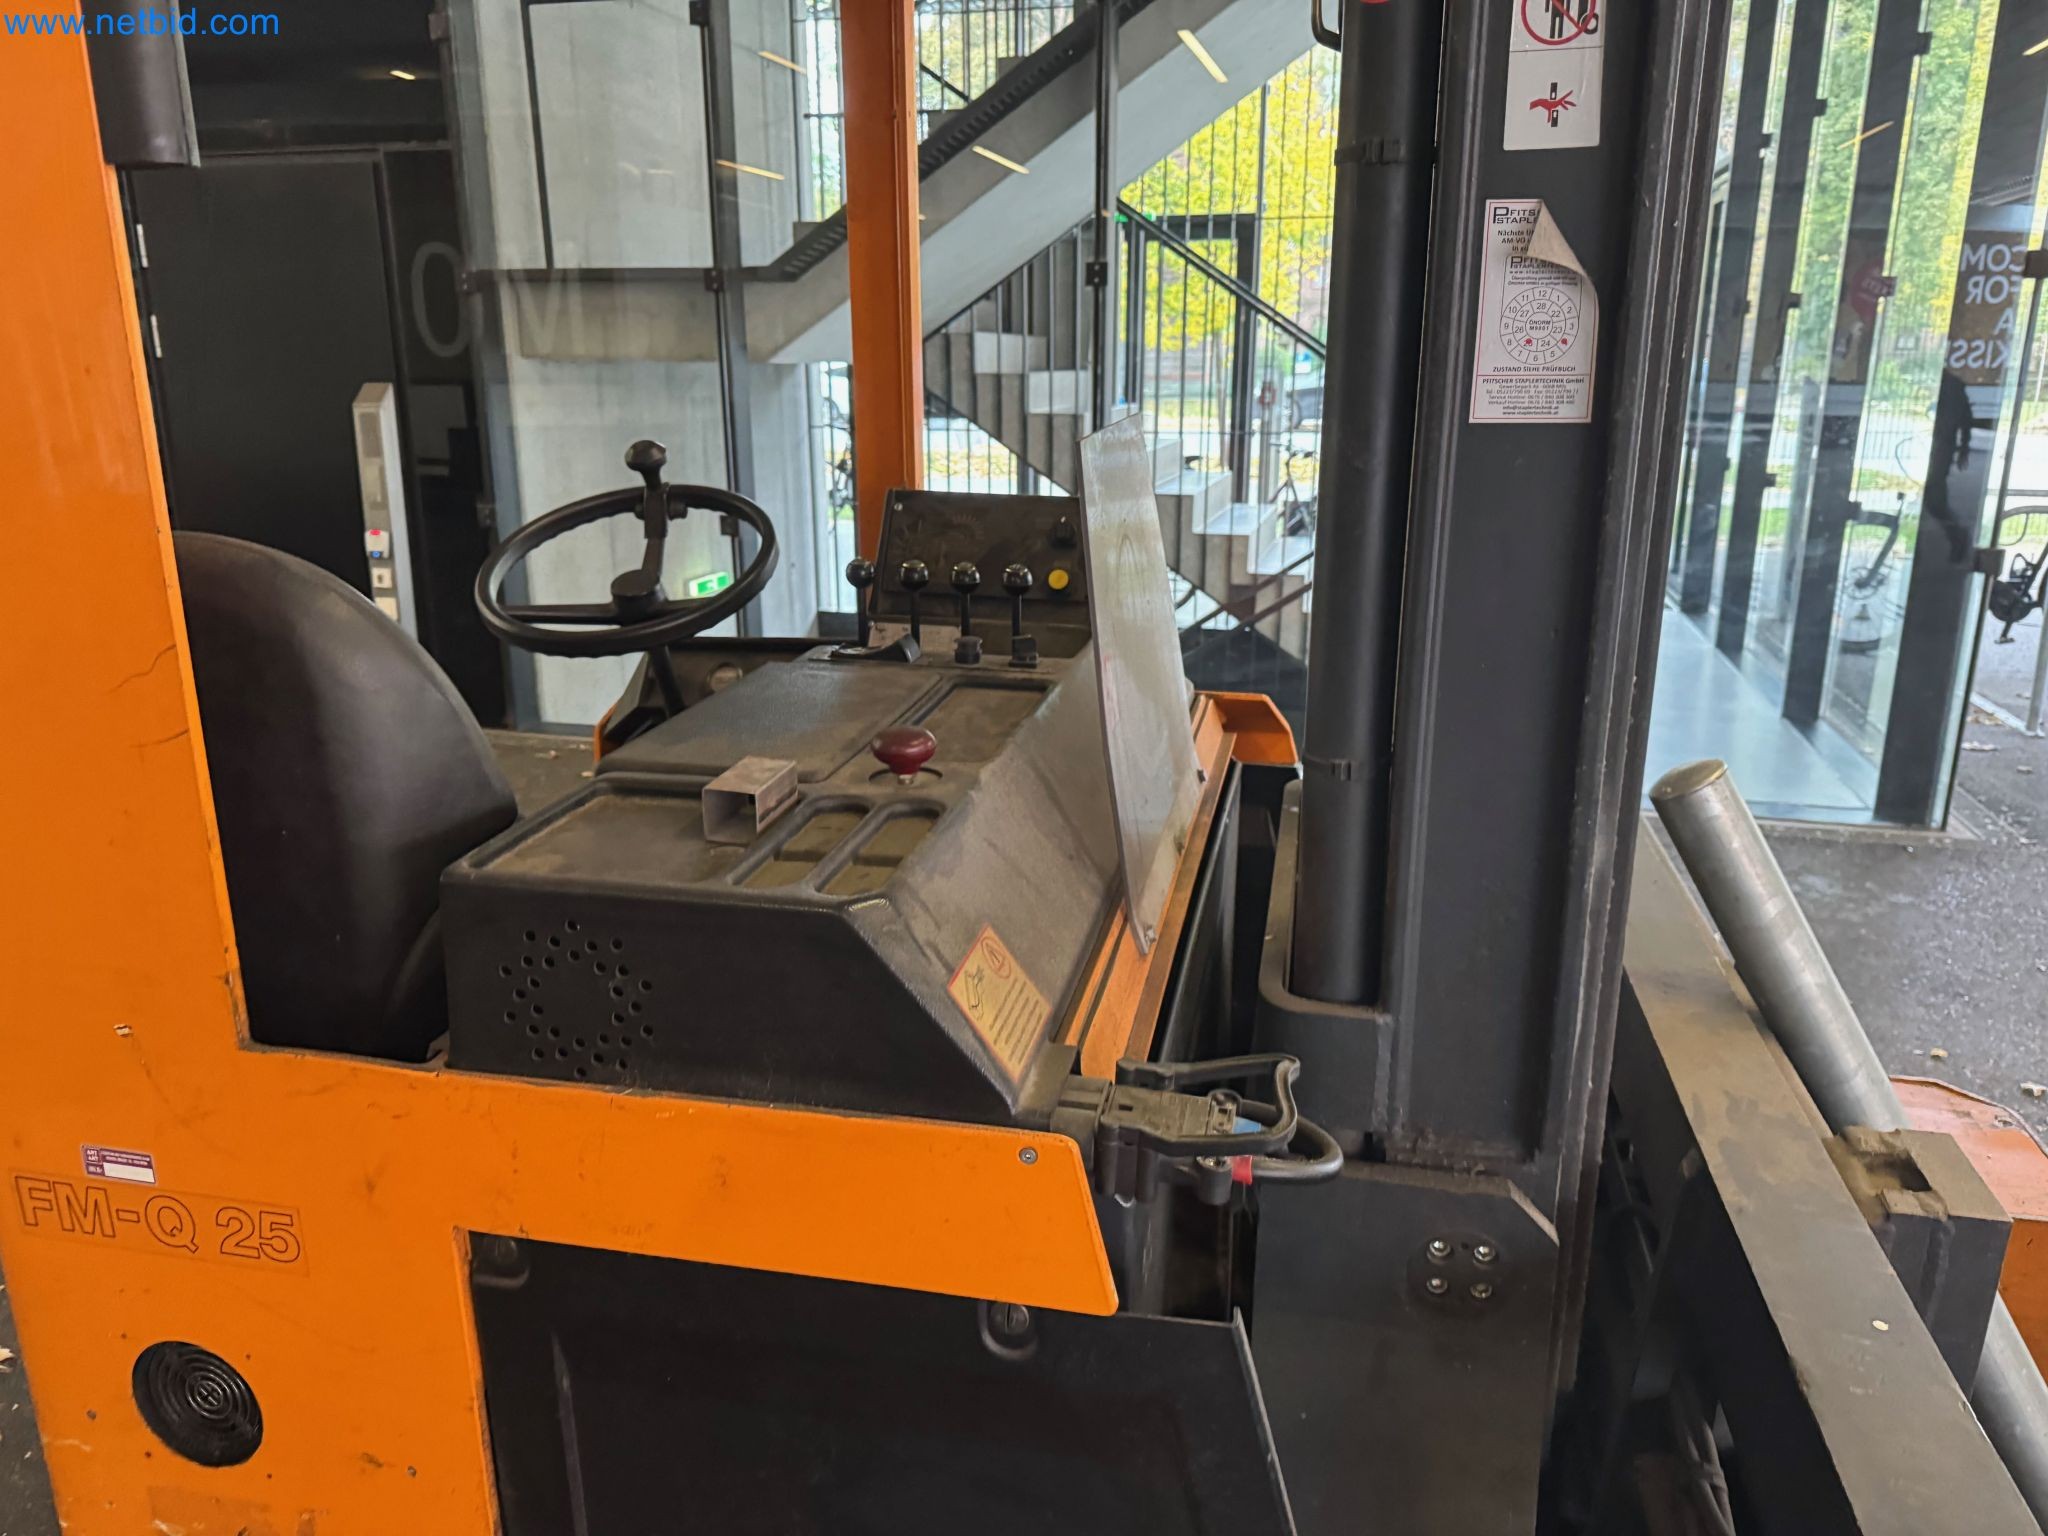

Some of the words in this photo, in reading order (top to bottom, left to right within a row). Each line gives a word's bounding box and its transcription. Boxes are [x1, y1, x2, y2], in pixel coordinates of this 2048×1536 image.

[1539, 289, 1548, 298] 12
[1522, 294, 1529, 302] 11
[1508, 306, 1518, 314] 10
[1536, 302, 1547, 310] 28
[1566, 306, 1573, 314] 2
[1520, 310, 1530, 318] 27
[1551, 310, 1561, 318] 22
[1503, 322, 1510, 330] 9
[1514, 326, 1525, 334] 26
[1552, 326, 1563, 334] 23
[1550, 350, 1556, 358] 5
[14, 1175, 200, 1254] FM-Q
[215, 1206, 301, 1263] 25
